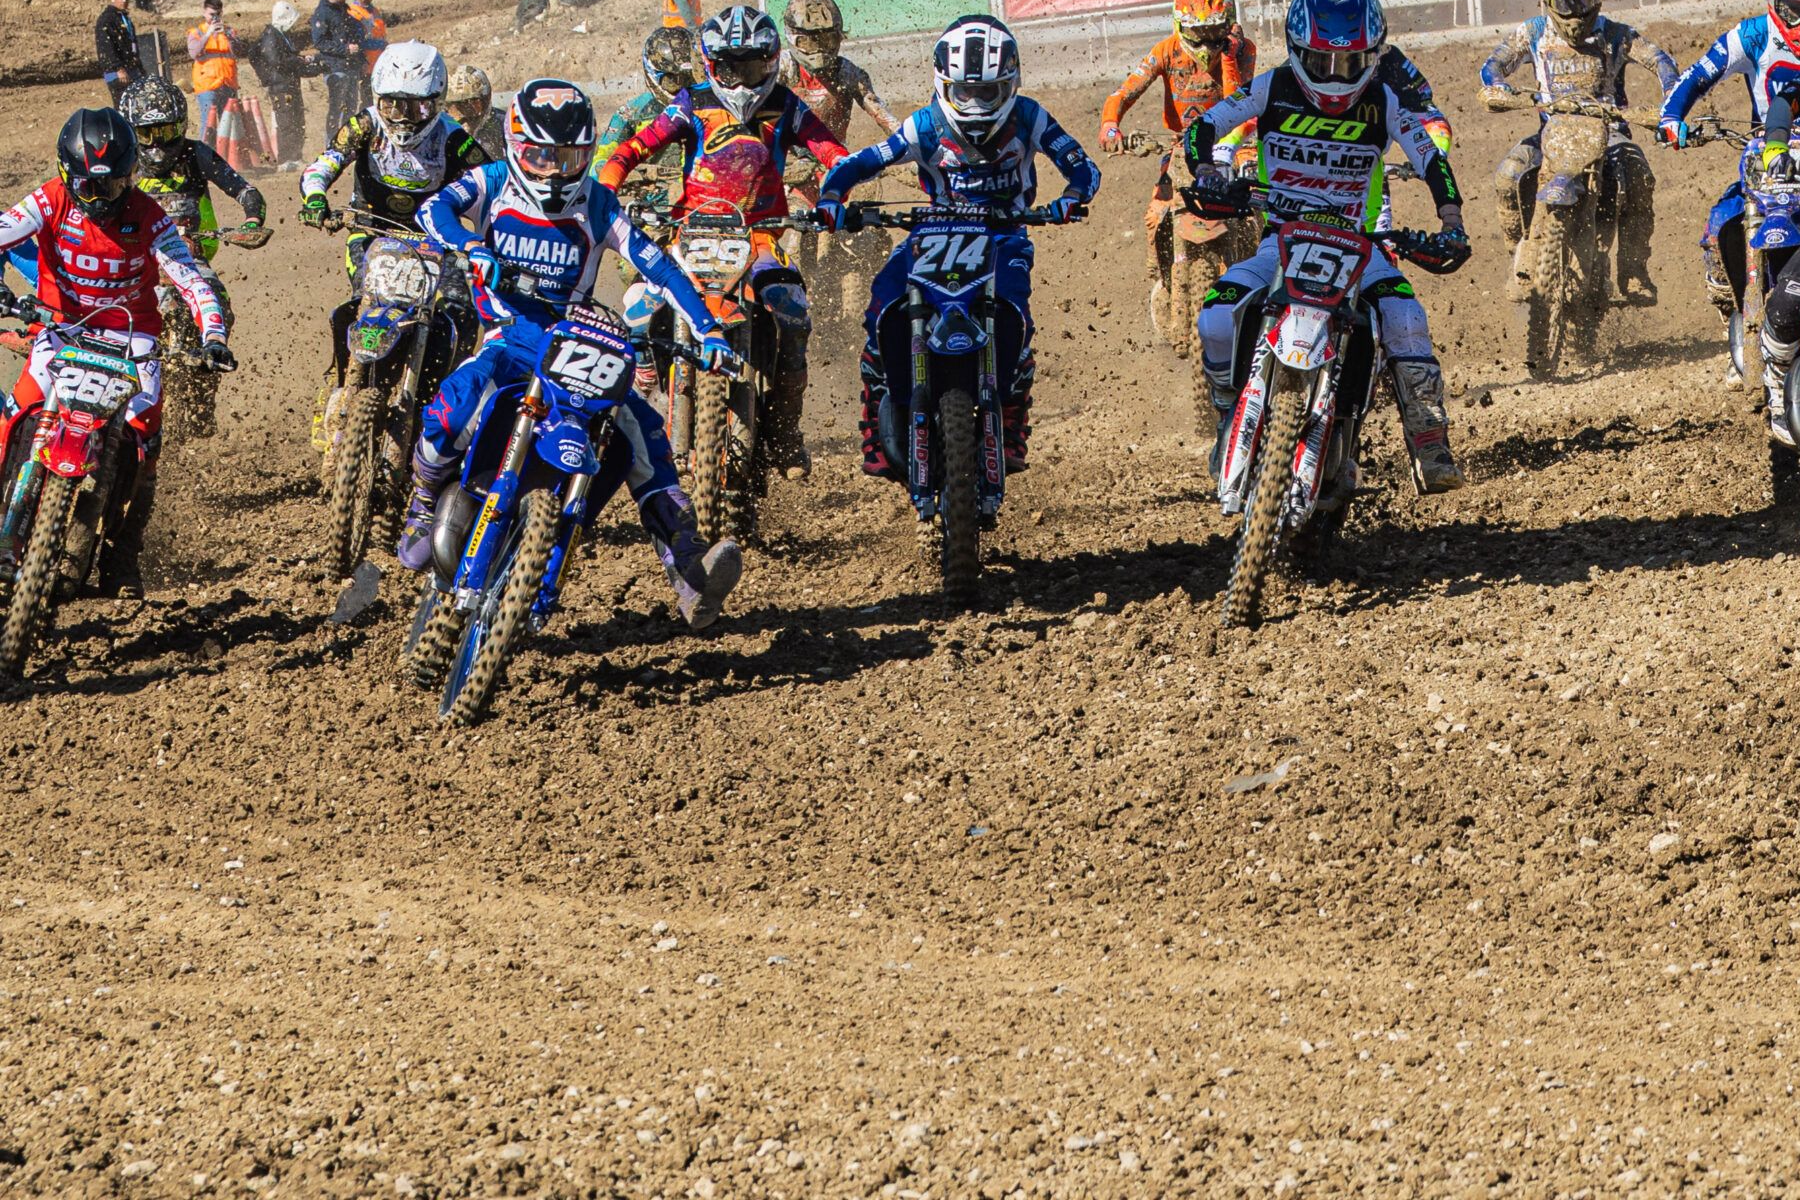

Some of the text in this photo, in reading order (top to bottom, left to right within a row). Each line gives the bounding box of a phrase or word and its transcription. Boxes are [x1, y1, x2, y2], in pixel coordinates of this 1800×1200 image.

[1280, 113, 1367, 141] UFO
[1269, 142, 1327, 166] TEAM
[1276, 137, 1359, 153] PLAST
[948, 168, 1019, 191] YAMAHA
[1271, 168, 1368, 191] FANTIC
[1329, 190, 1363, 198] RACING
[916, 207, 990, 215] RENTHAL
[917, 226, 948, 234] JOSELU
[1293, 229, 1314, 238] IVAN
[56, 245, 145, 274] MOTS
[493, 230, 580, 266] YAMAHA
[685, 237, 751, 273] 29
[913, 235, 989, 274] 214
[531, 264, 564, 276] GRUP
[1285, 243, 1360, 291] 151
[569, 326, 625, 351] E.CASTRO
[77, 351, 131, 374] MOTOREX
[550, 340, 626, 390] 128
